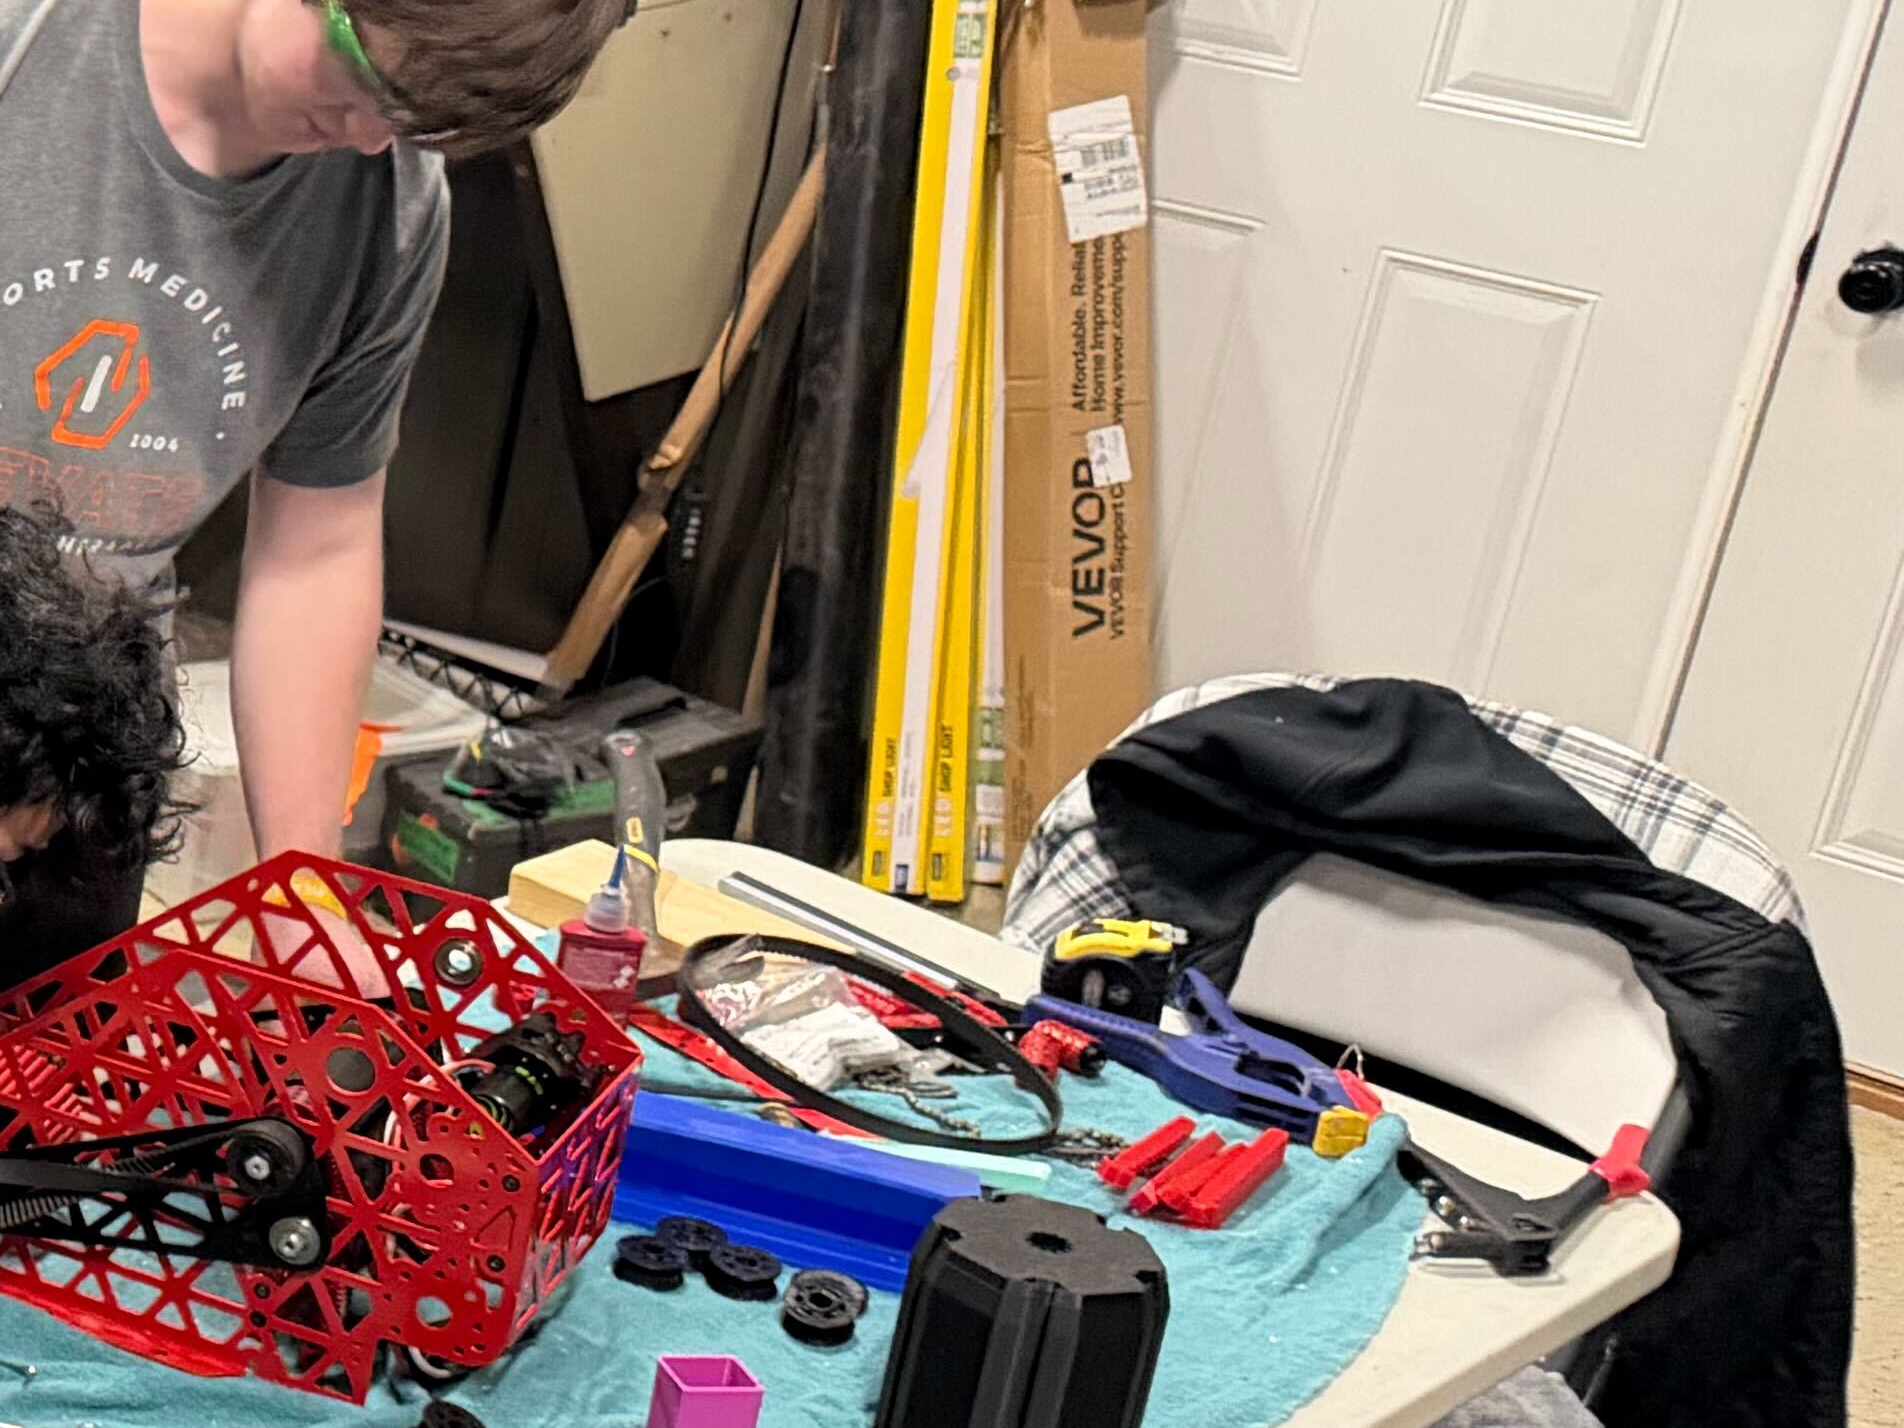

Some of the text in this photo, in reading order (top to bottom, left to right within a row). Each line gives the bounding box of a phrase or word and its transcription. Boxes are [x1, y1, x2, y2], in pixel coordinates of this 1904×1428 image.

[128, 257, 248, 413] MEDICINE
[1071, 302, 1087, 412] Affordable.
[1090, 354, 1106, 412] Home
[1110, 503, 1128, 573] Support
